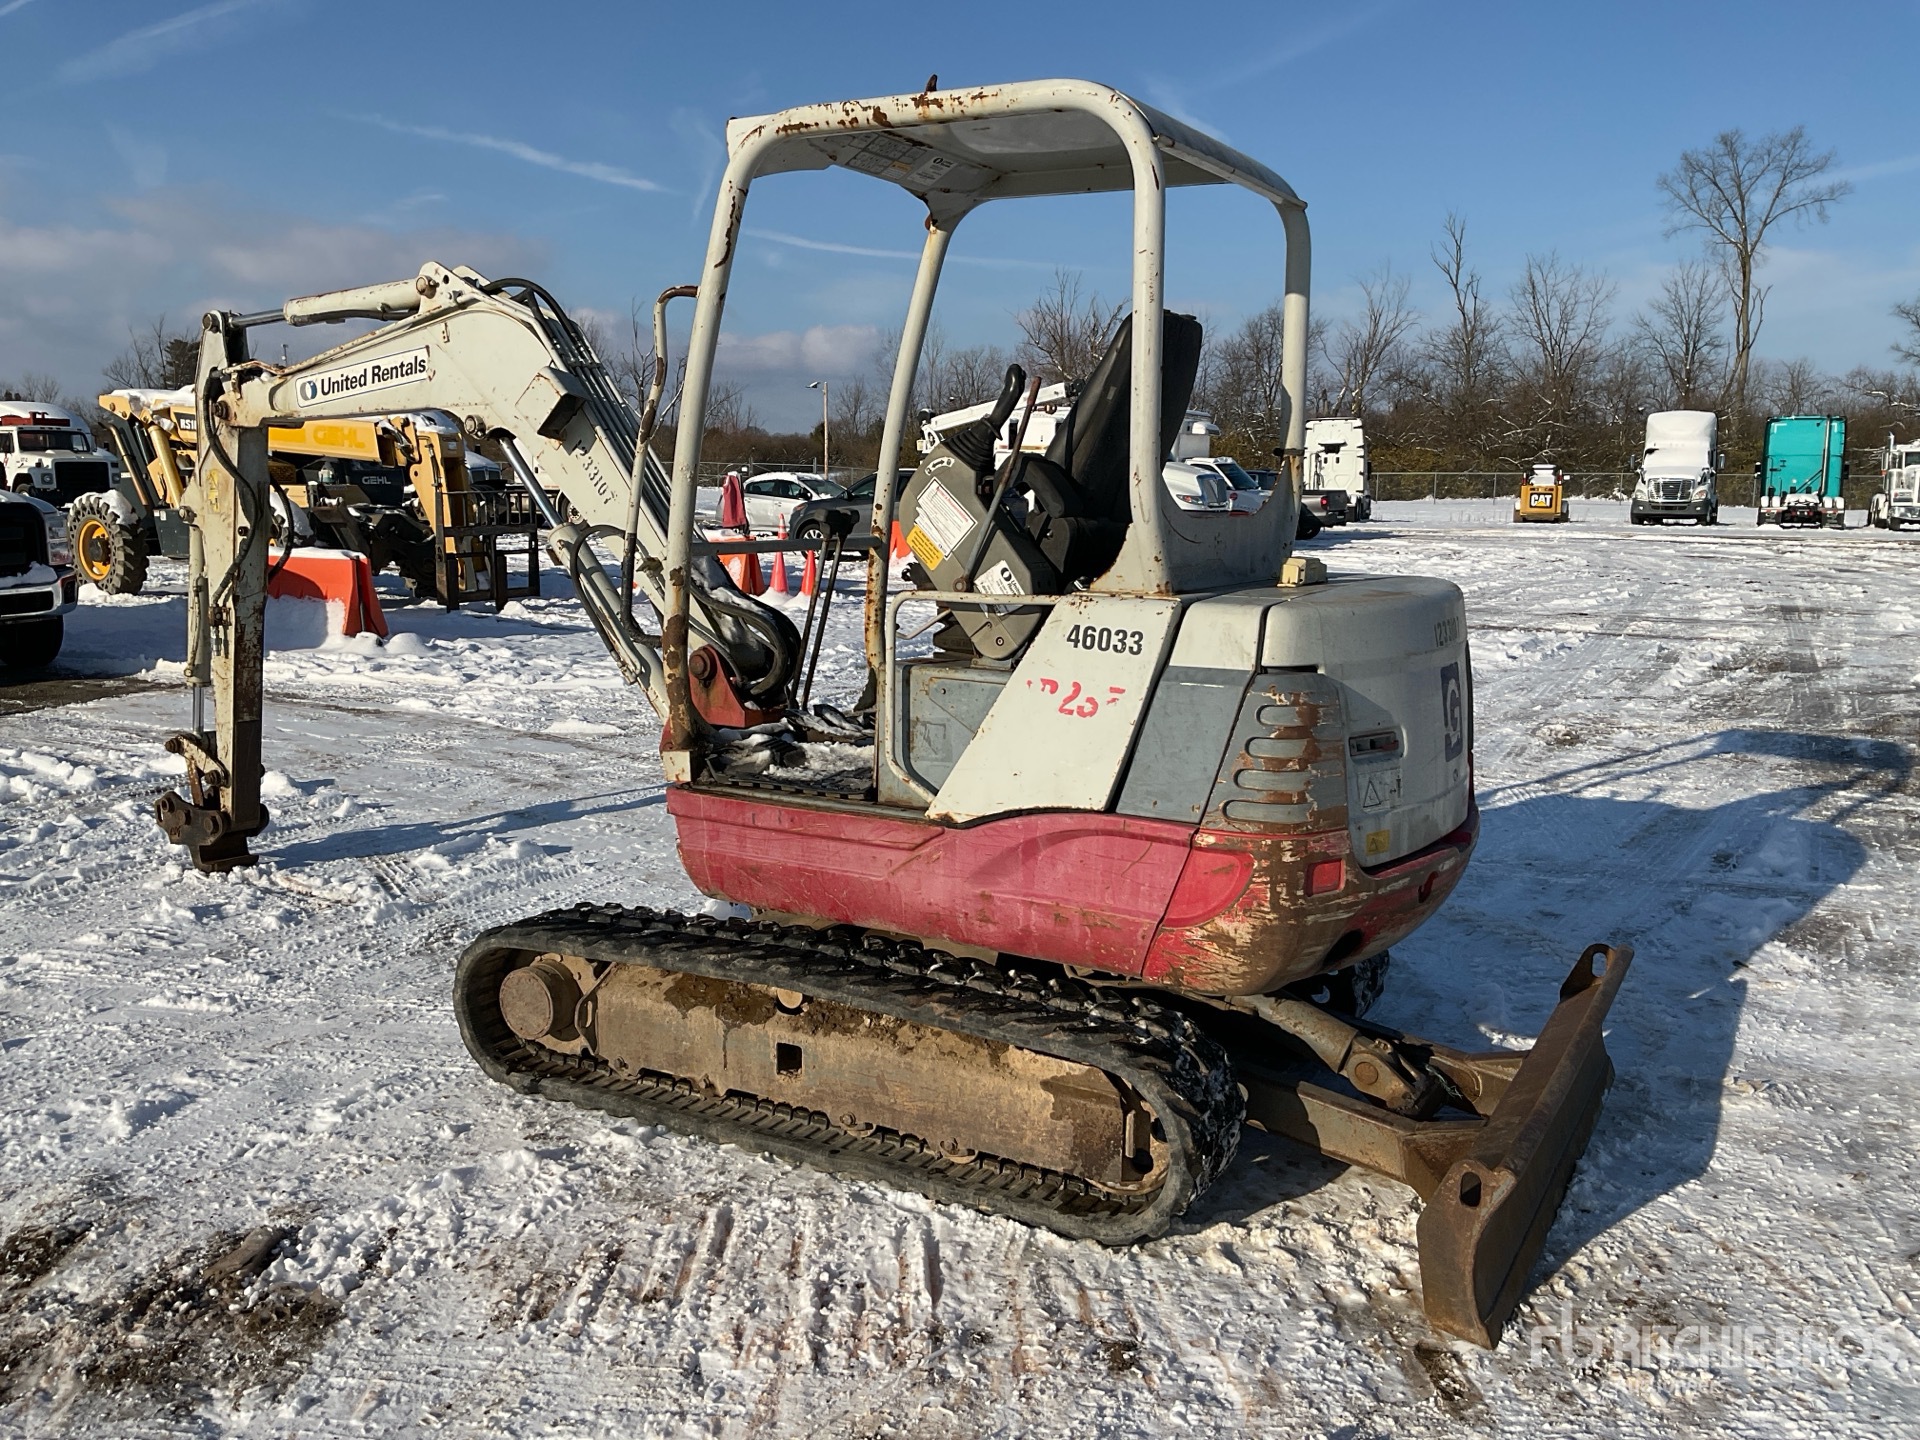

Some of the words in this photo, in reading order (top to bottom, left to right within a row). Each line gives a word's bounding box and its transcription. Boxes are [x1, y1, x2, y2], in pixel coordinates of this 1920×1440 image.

[320, 371, 368, 397] United
[371, 355, 427, 385] Rentals
[313, 424, 366, 449] GEHL
[361, 475, 392, 485] GEHL
[1530, 493, 1552, 507] CAT
[1066, 624, 1145, 656] 46033
